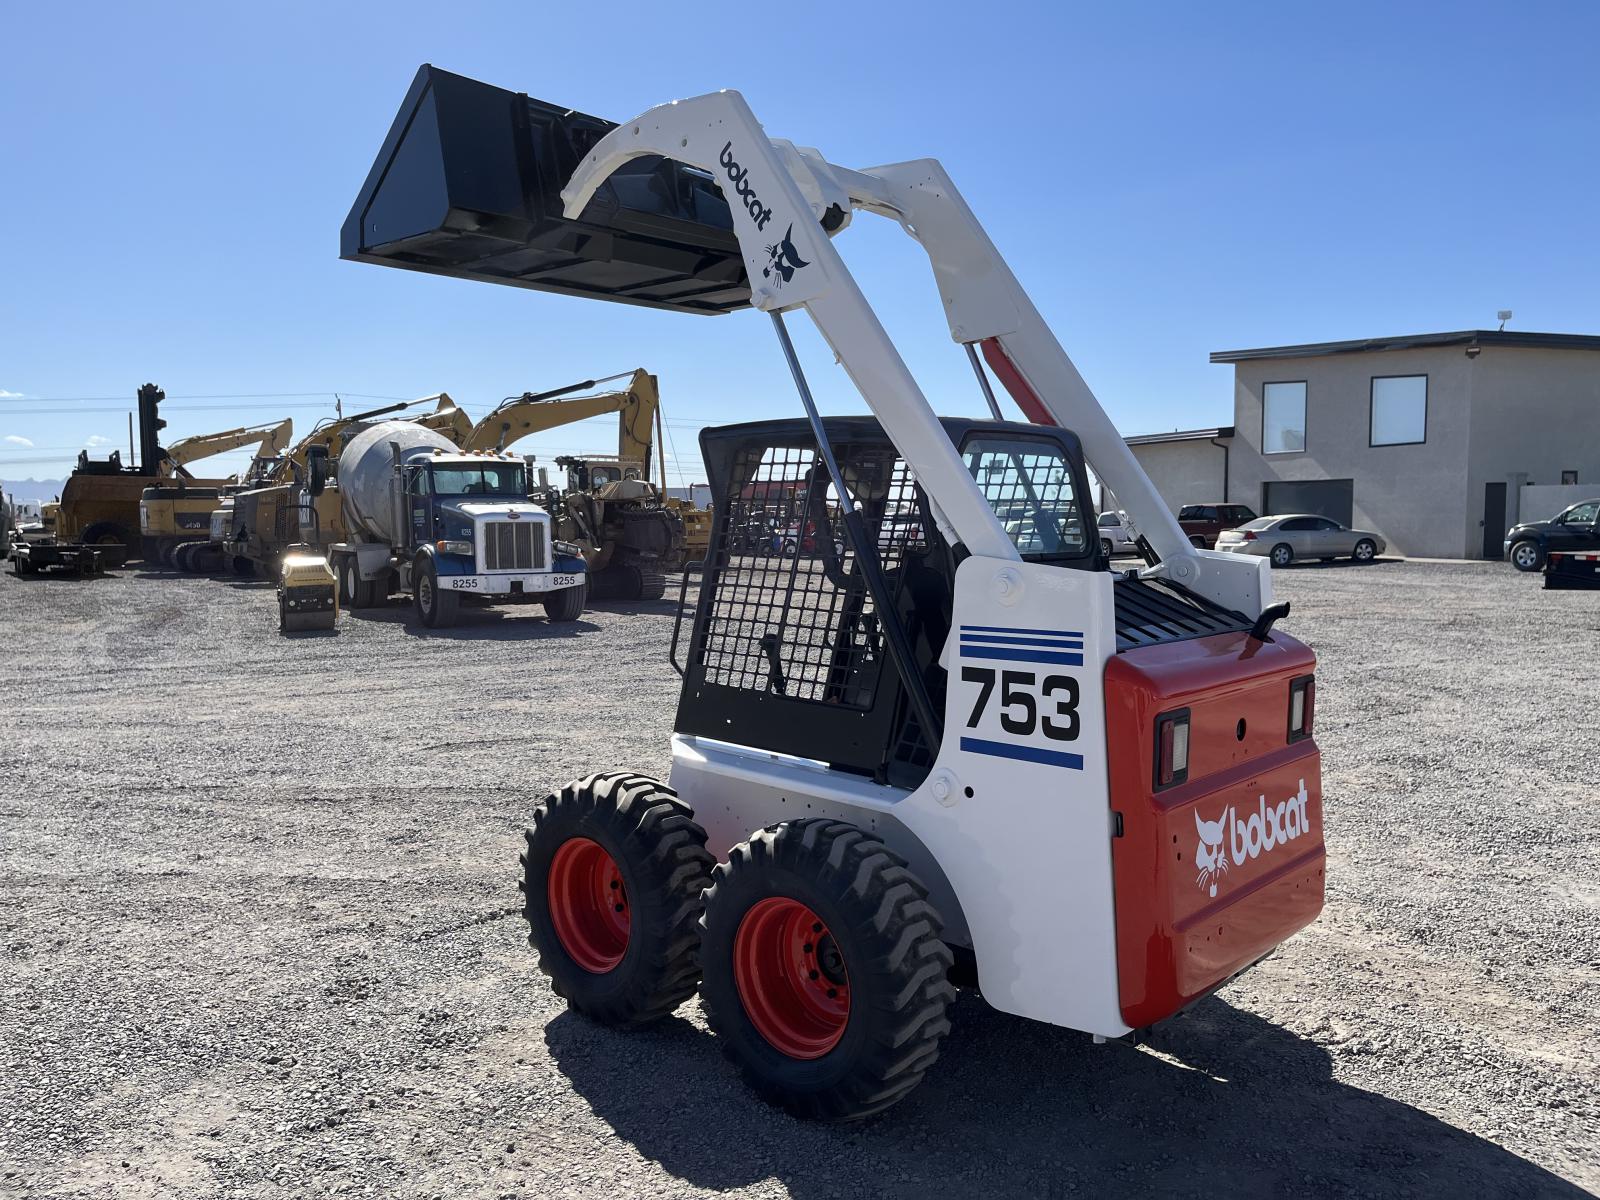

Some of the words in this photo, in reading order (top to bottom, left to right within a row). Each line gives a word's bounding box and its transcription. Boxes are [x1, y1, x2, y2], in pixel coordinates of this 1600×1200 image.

[719, 140, 772, 232] bobcat
[452, 578, 478, 589] 8255
[553, 576, 575, 586] 8255
[961, 665, 1081, 742] 753
[1229, 778, 1310, 866] bobcat
